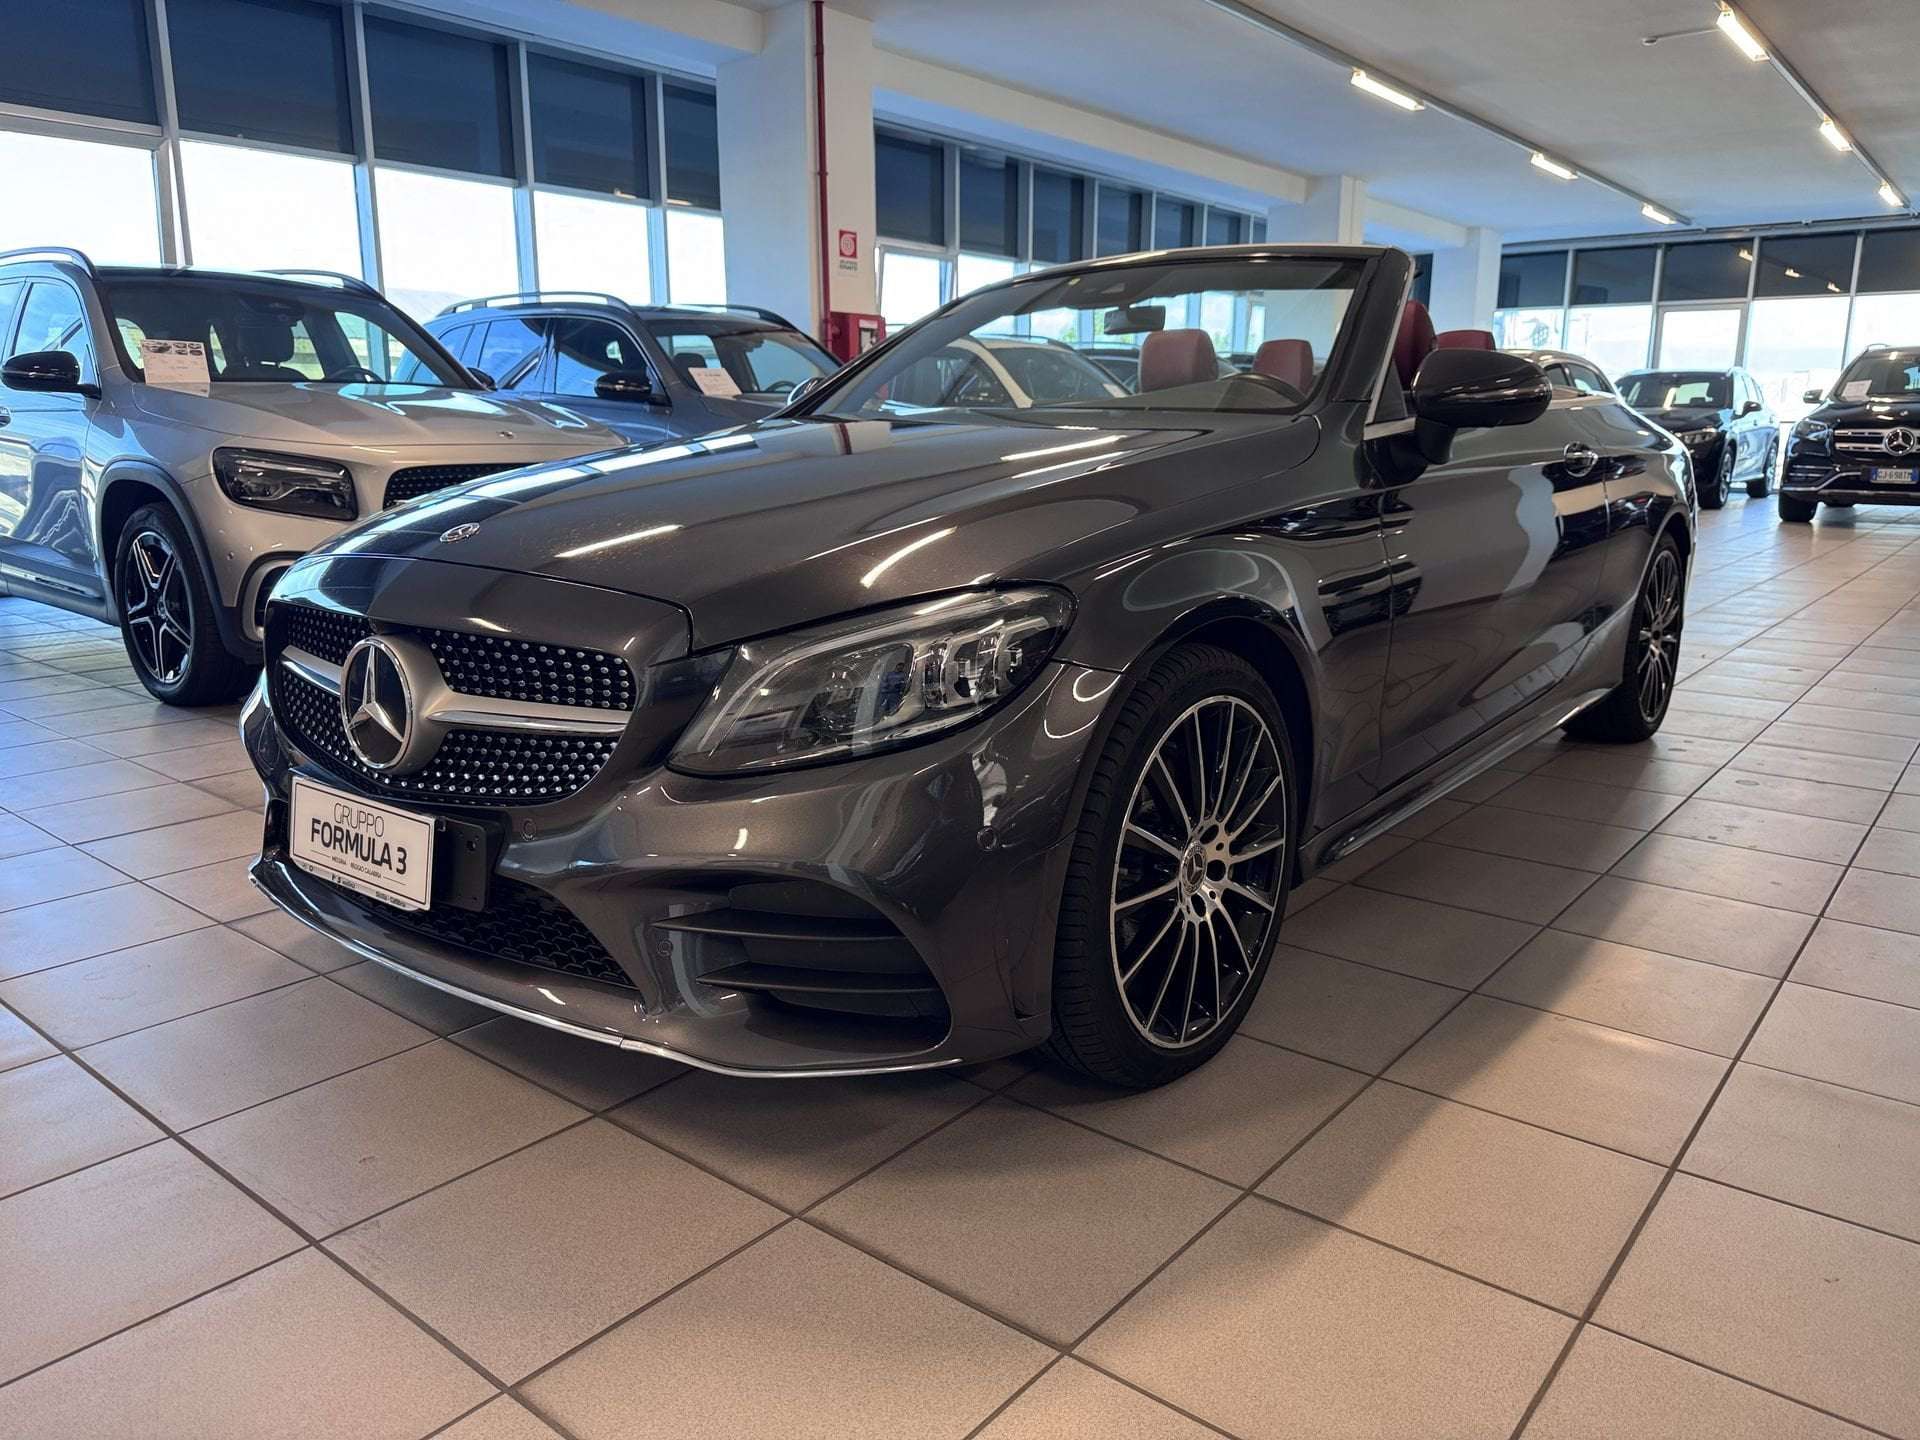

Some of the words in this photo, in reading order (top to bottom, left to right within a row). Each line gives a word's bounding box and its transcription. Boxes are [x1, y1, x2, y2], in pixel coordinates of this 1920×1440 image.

[333, 802, 385, 838] GRUPPO
[310, 817, 393, 871] FORMULA
[396, 846, 408, 875] 3
